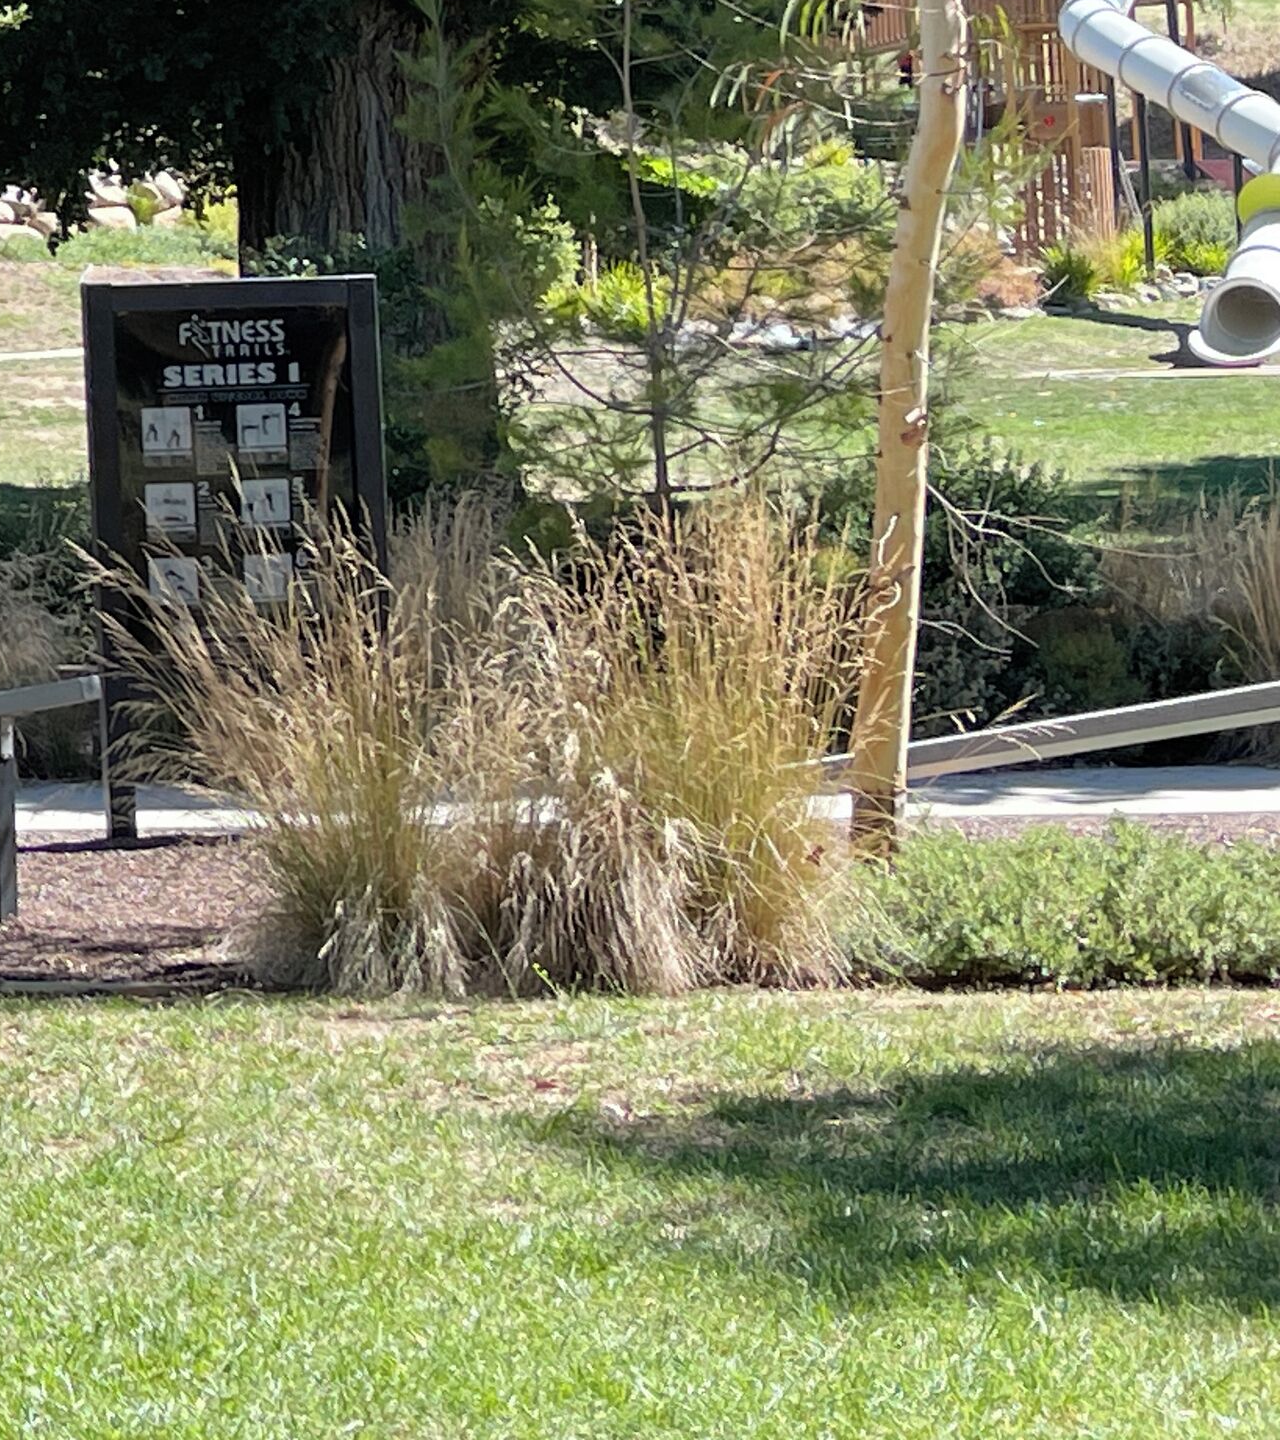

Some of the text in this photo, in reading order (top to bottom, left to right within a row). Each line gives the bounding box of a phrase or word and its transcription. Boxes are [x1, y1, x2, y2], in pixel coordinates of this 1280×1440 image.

[178, 316, 285, 345] FITNESS
[211, 343, 285, 358] TRAILS
[163, 362, 277, 388] SERIES
[193, 405, 205, 421] 1
[288, 401, 302, 417] 4
[196, 480, 210, 497] 2
